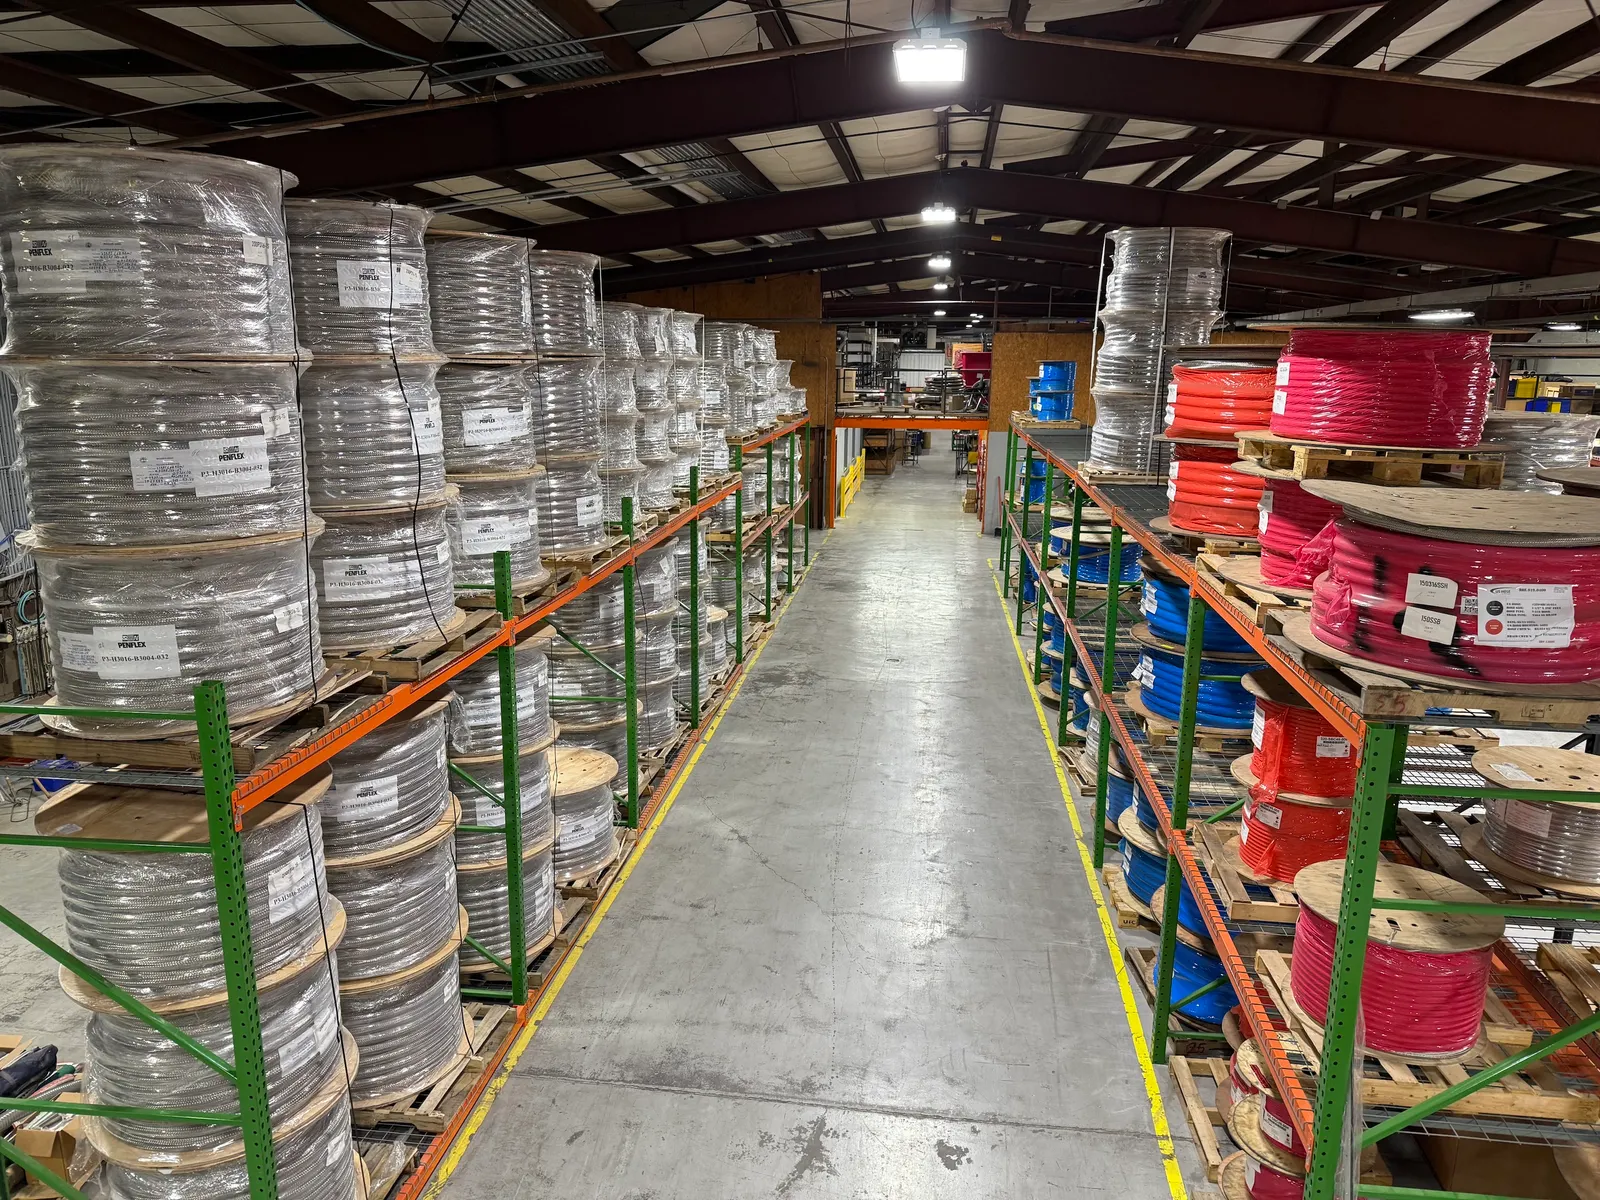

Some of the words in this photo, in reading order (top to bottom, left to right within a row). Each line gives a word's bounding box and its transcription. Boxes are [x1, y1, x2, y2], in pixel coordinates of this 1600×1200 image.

[29, 248, 53, 257] PENFLEX
[218, 452, 245, 462] PENFLEX
[200, 464, 263, 478] P3-H3016-B3004-032
[329, 579, 384, 588] P3-H3016-B3004-03
[1419, 579, 1449, 589] 150316SSH
[1421, 615, 1442, 625] 150SSB
[117, 641, 147, 649] PENFLEX
[101, 653, 169, 662] P3-H3016-B3004-032
[356, 790, 378, 799] PENFLEX
